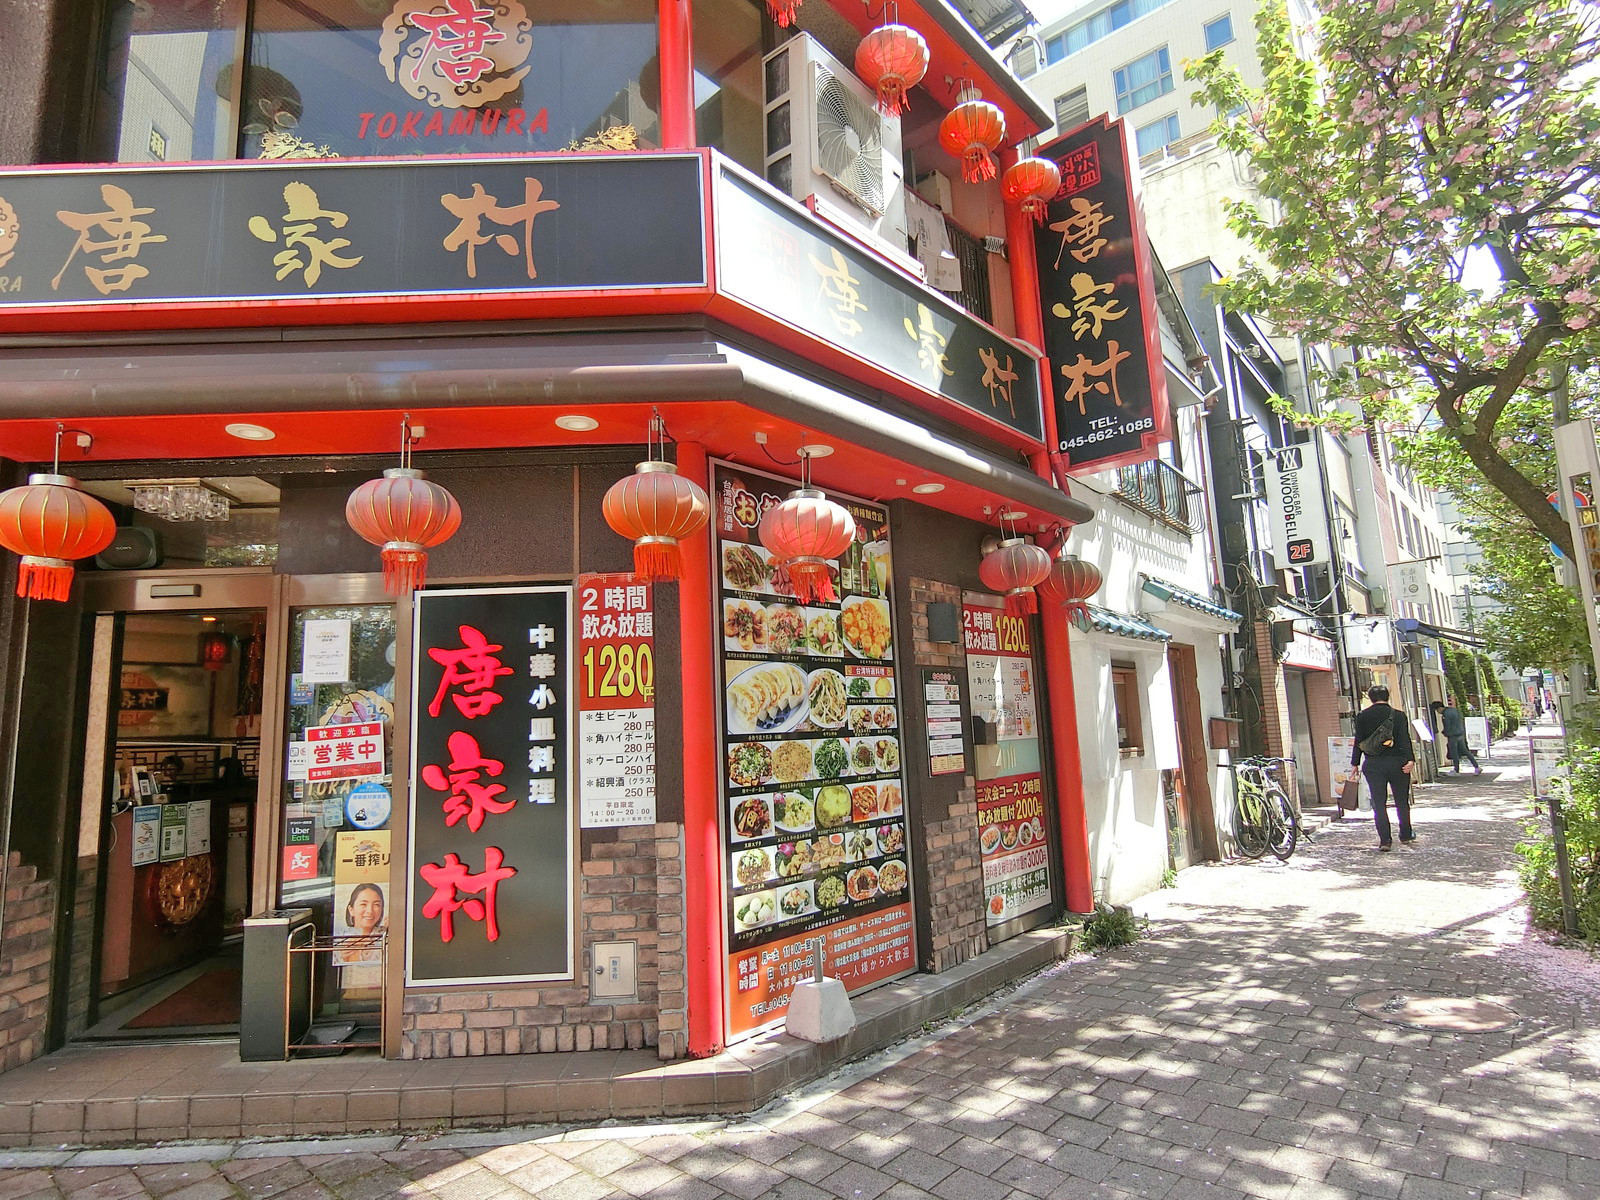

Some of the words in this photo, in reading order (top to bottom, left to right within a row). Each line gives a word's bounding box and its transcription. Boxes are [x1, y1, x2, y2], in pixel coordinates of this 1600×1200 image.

[358, 107, 550, 140] TOKAMURA
[51, 175, 560, 295] 唐家村
[1049, 197, 1132, 417] 唐家村
[808, 246, 1020, 420] 唐家村
[1059, 417, 1153, 451] 045-662-1088
[1088, 416, 1118, 431] TEL:
[1290, 471, 1301, 500] DINING
[1280, 473, 1298, 541] WOODBELL
[1293, 500, 1303, 516] BAR
[1290, 544, 1311, 560] 2F
[581, 611, 654, 640] 飲み放題
[965, 629, 997, 652] 飲み放題
[528, 623, 557, 804] 中華小皿料理
[313, 740, 377, 765] 営業中
[311, 769, 332, 778] 営業時間
[421, 624, 519, 943] 唐家村
[976, 782, 1020, 803] 二次会コース
[1022, 778, 1041, 795] 2時間
[978, 803, 1015, 827] 飲み放題付
[291, 827, 310, 835] Uber
[291, 834, 310, 842] Eats
[342, 853, 391, 867] 一番搾り
[738, 955, 758, 975] 営業
[767, 966, 775, 981] 日
[738, 972, 759, 991] 時間
